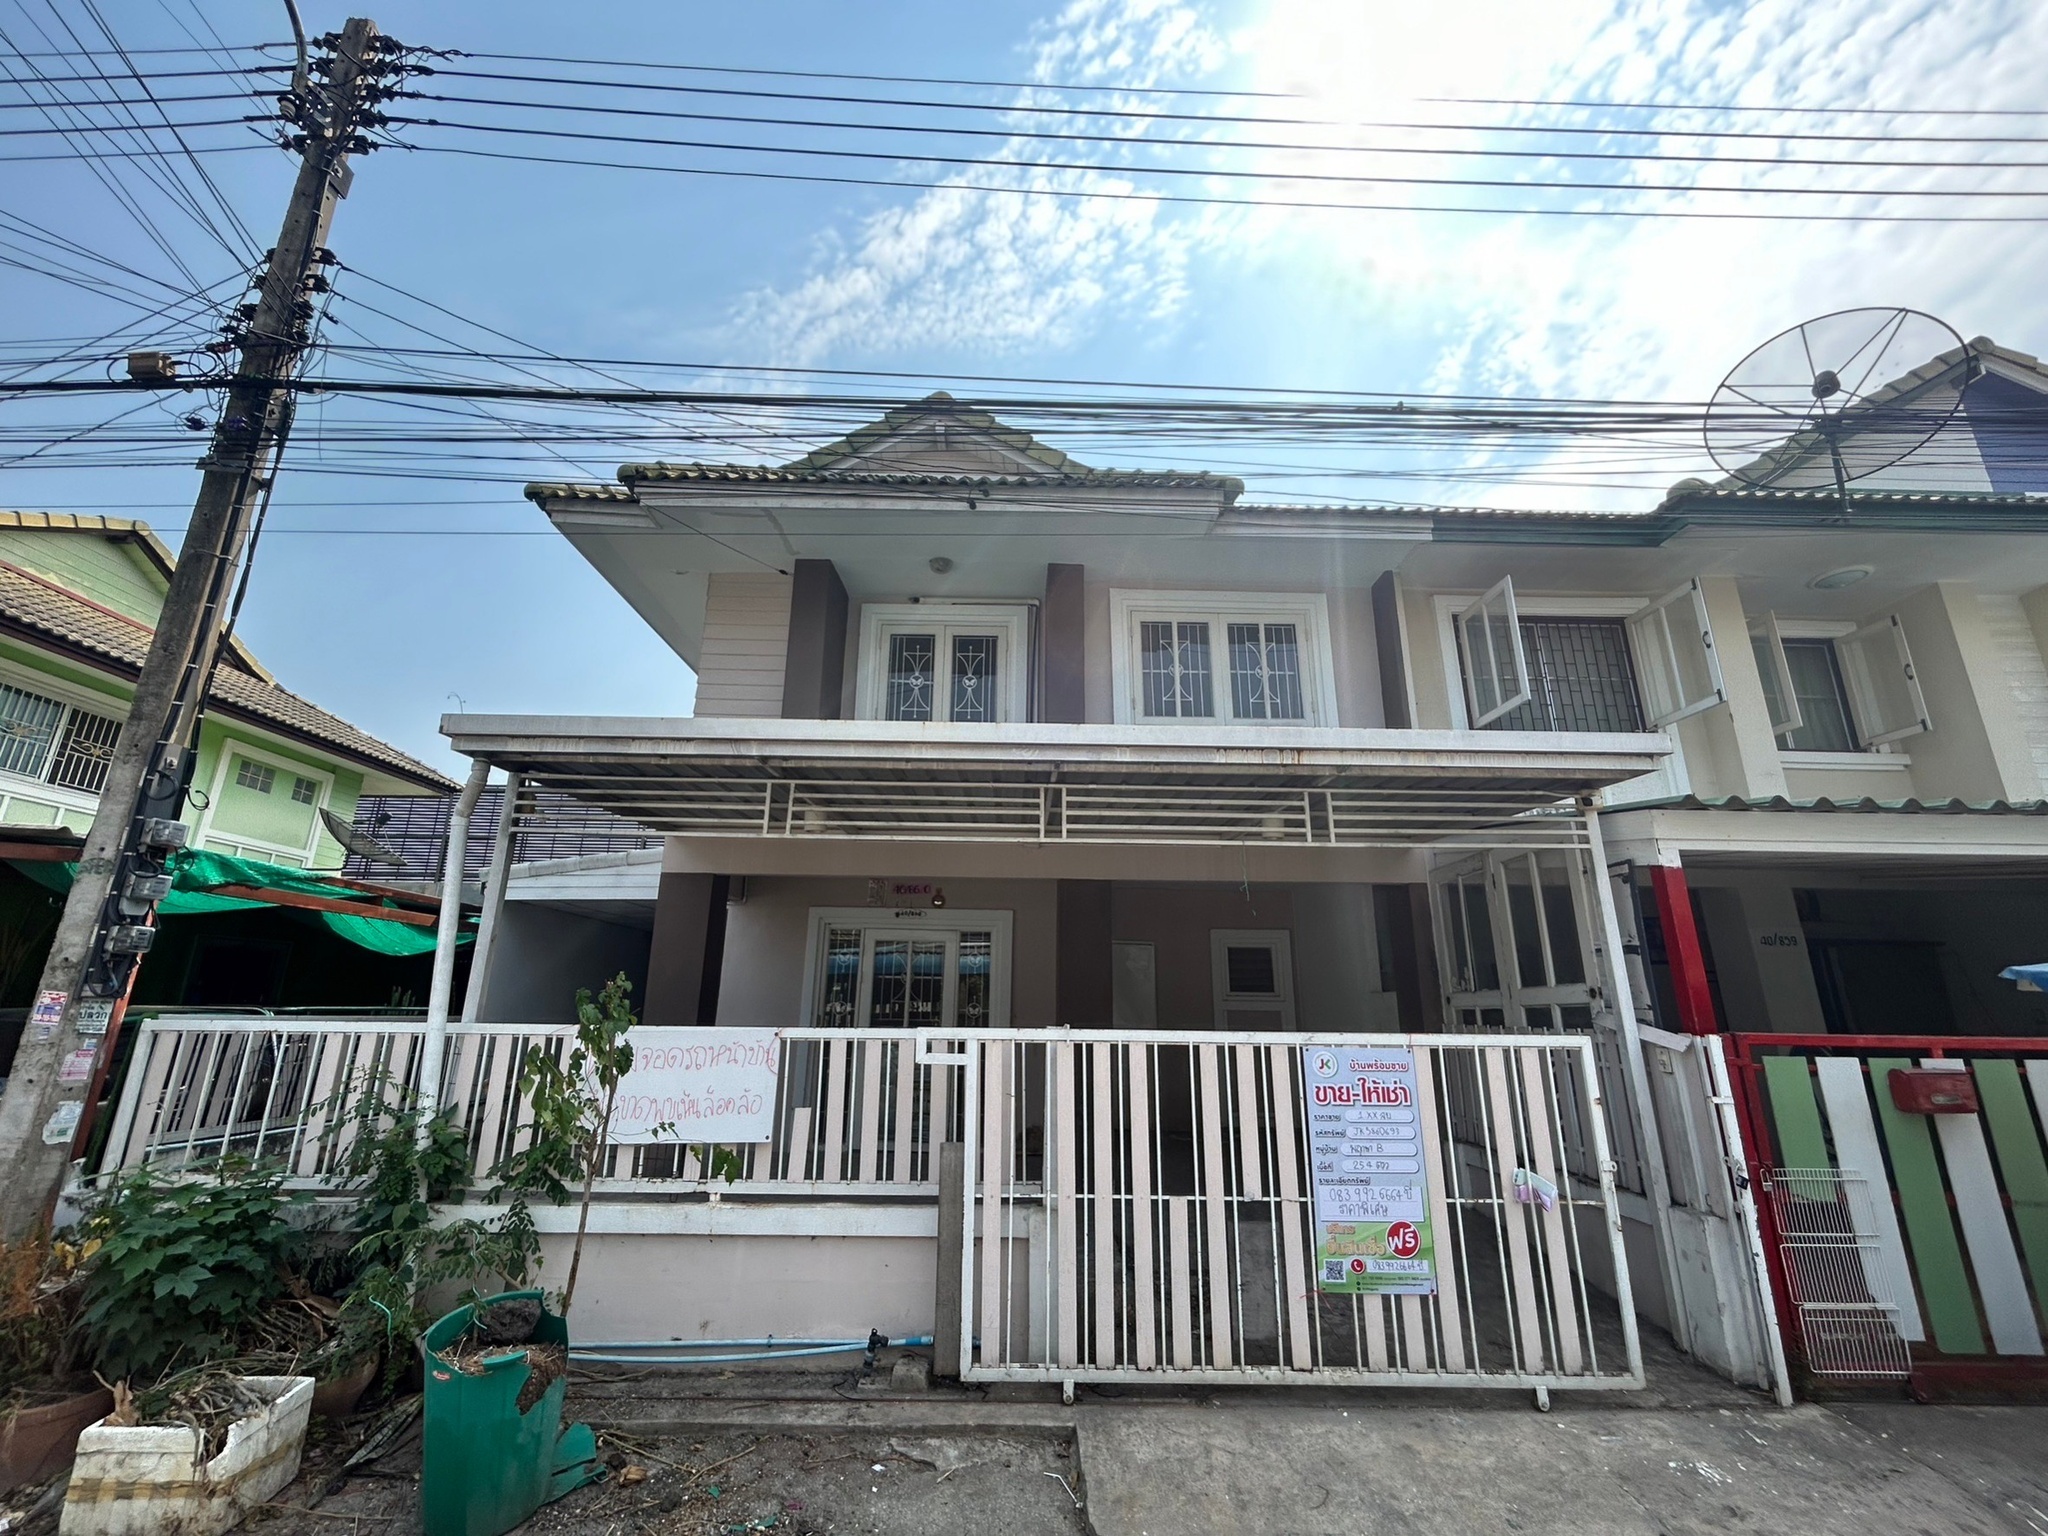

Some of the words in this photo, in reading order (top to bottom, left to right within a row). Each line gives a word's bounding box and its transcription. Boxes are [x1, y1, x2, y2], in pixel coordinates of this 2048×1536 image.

[588, 1039, 777, 1076] จอดรถหน้าบ้าน
[1314, 1077, 1410, 1104] ขาย-ให้เช่า
[1388, 1227, 1416, 1250] ฟรี
